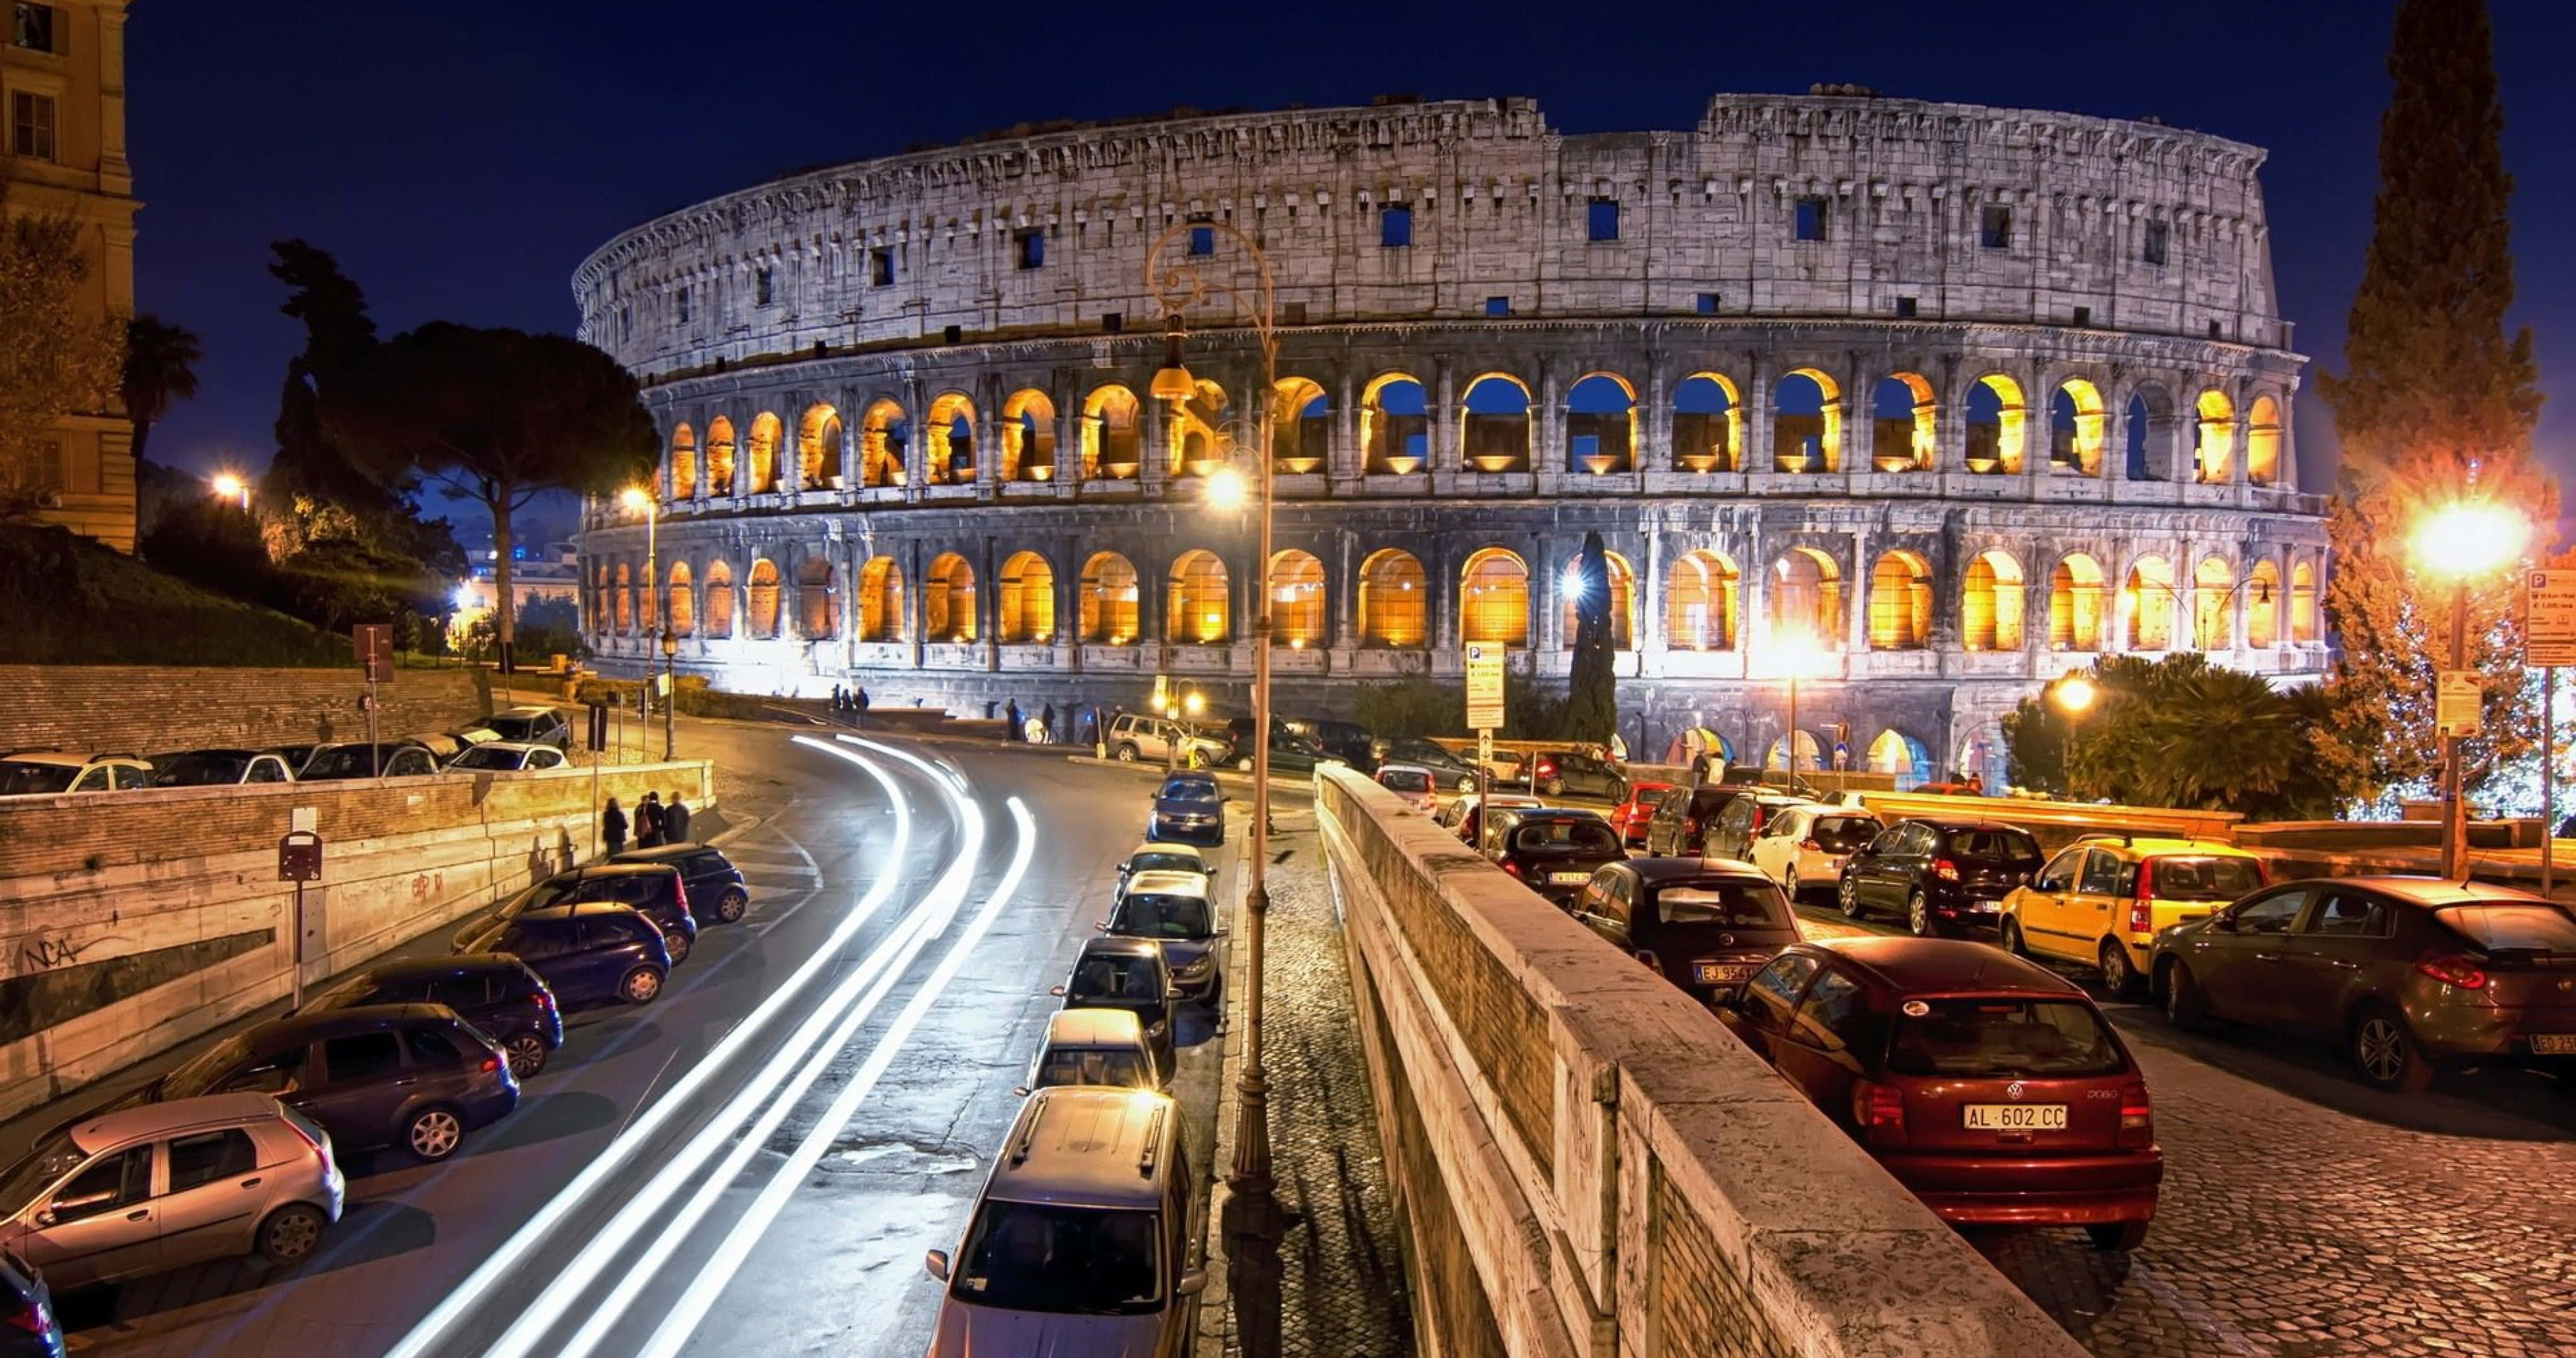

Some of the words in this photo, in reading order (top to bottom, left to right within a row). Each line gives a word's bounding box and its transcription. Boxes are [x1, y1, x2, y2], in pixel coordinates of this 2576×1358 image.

[1703, 967, 1718, 979] EJ
[1969, 1108, 1990, 1127] AL
[2001, 1108, 2035, 1127] 602
[2043, 1108, 2063, 1127] CC
